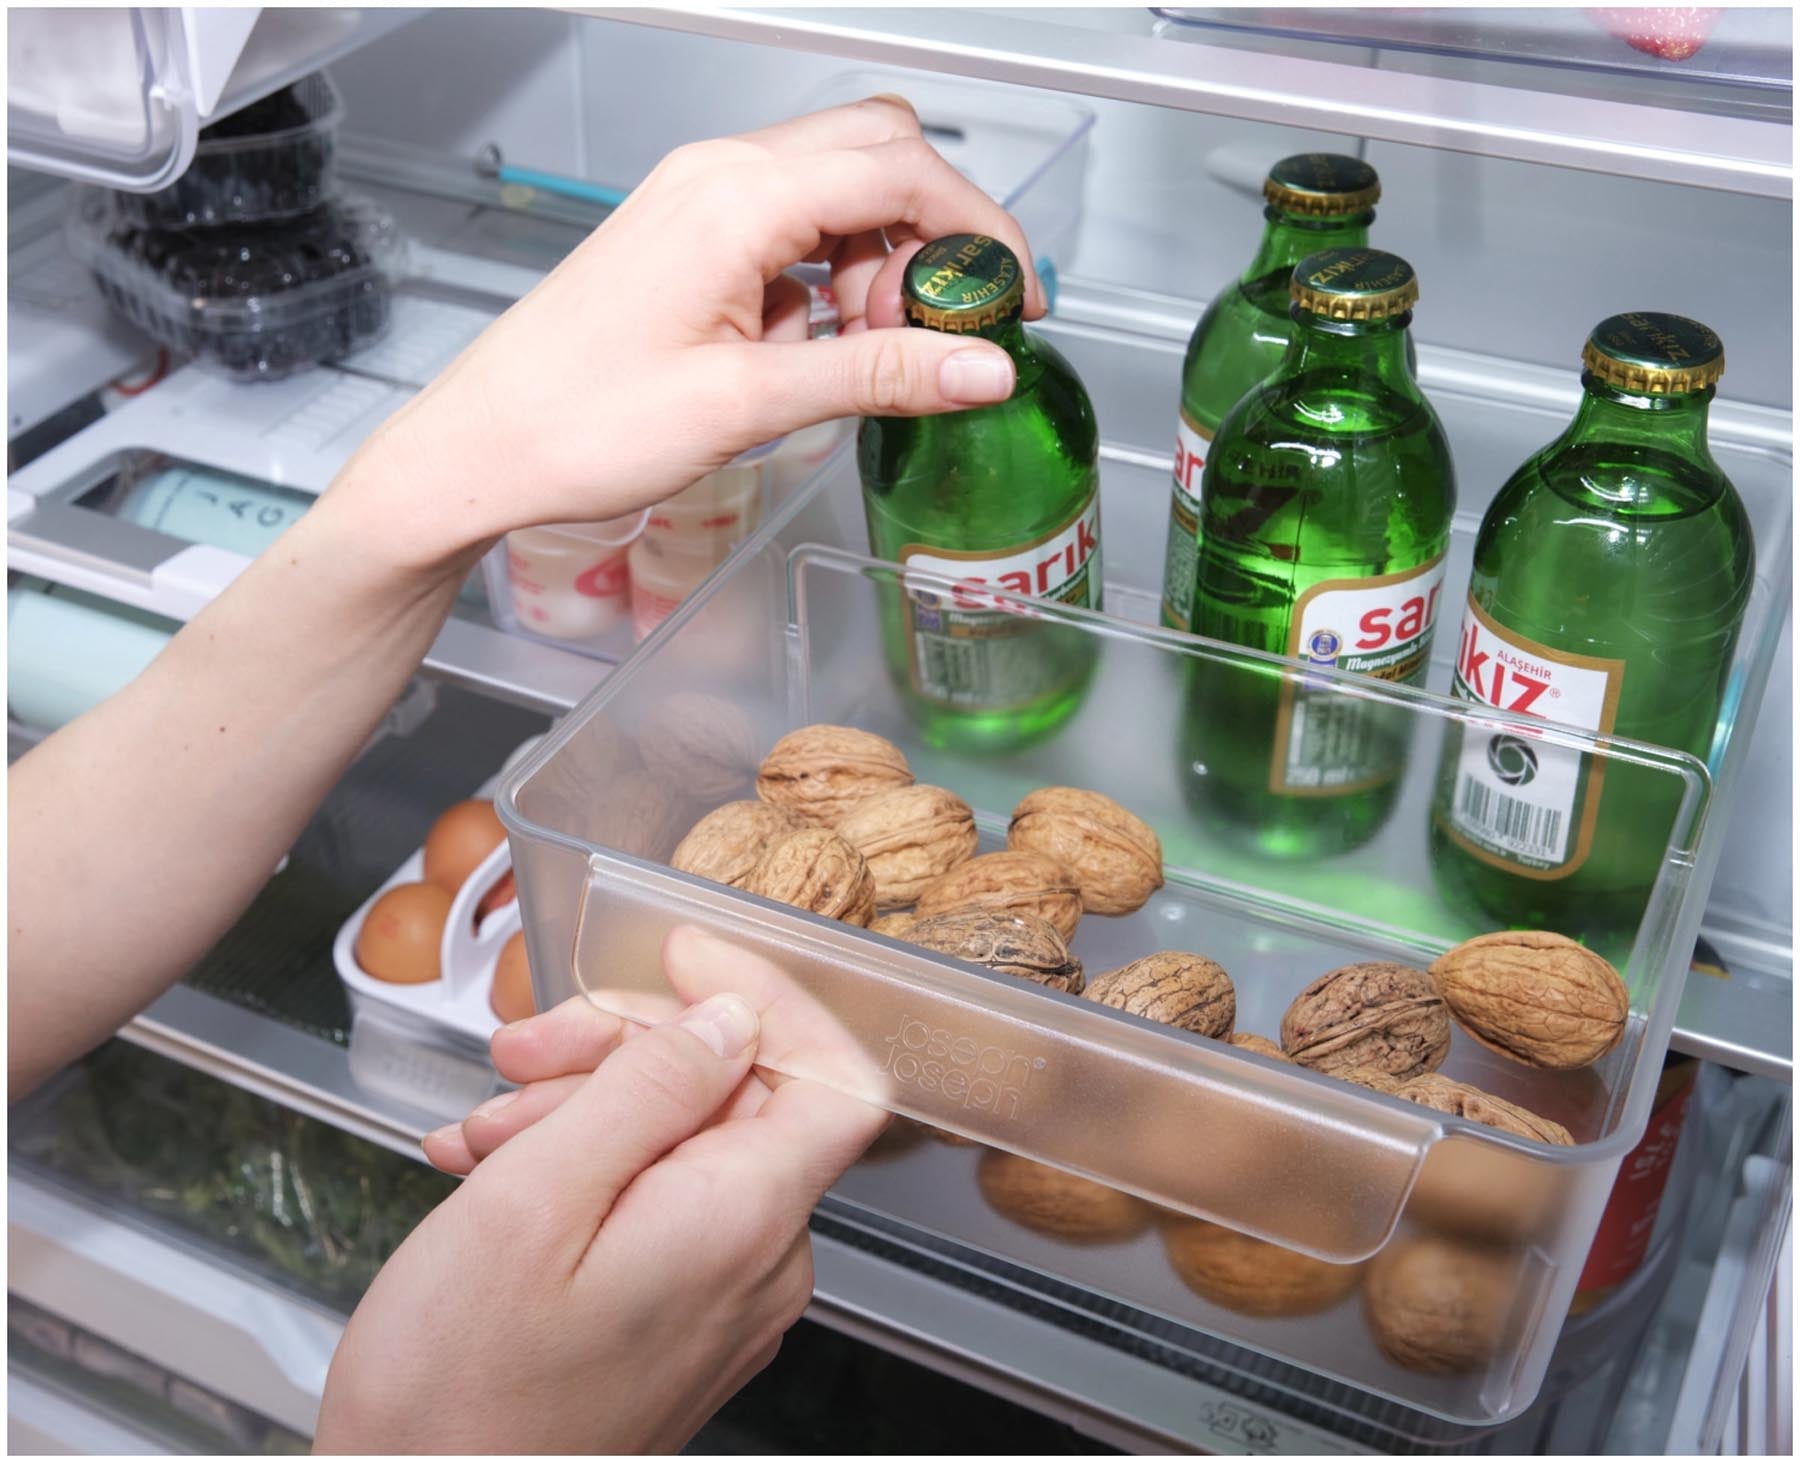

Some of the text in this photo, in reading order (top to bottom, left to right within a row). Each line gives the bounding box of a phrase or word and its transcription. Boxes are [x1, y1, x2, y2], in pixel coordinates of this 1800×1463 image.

[1355, 576, 1443, 650] sar
[1497, 650, 1553, 681] ALAŞEHİR
[876, 1043, 1024, 1121] Joseph
[885, 1014, 1033, 1087] Joseph
